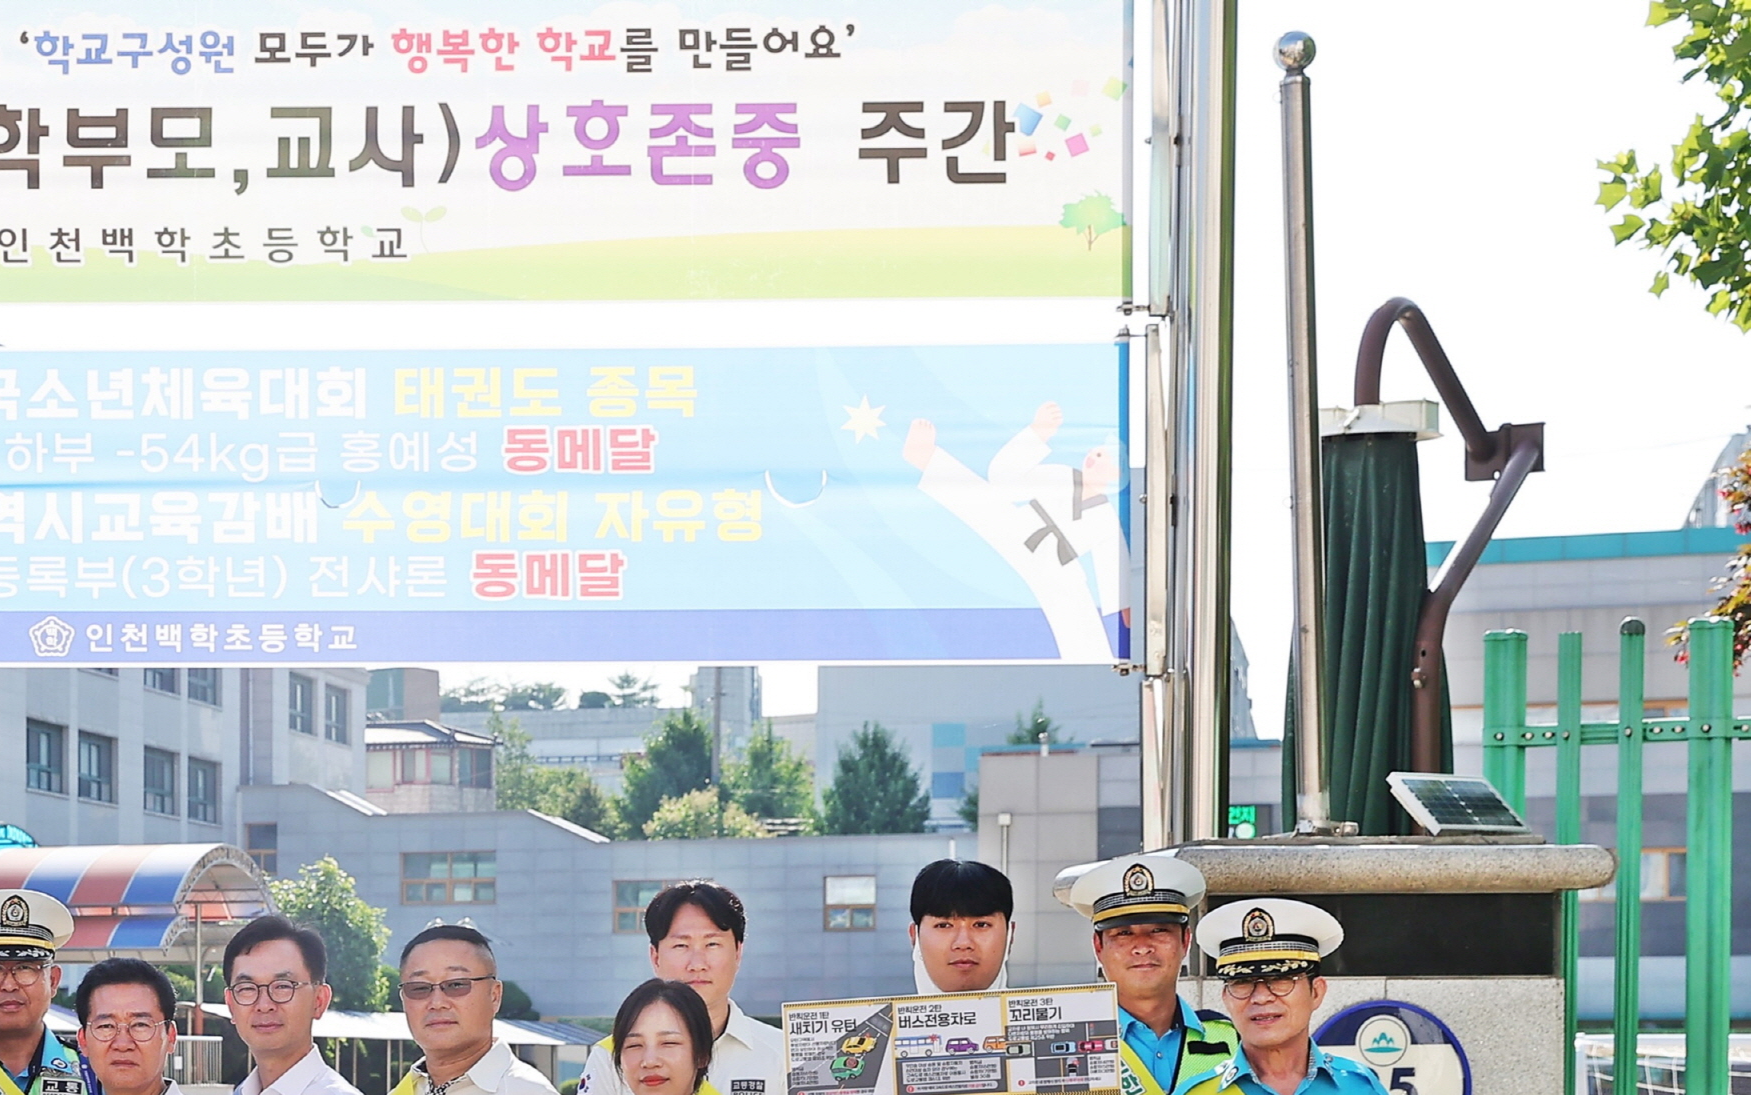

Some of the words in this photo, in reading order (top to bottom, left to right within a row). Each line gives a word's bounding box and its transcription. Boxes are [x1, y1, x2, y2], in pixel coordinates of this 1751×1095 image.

[254, 29, 375, 66] 모두가
[392, 28, 520, 75] 행복한
[537, 26, 659, 75] 학교를
[858, 98, 1016, 186] 주간
[393, 364, 562, 419] 태권도
[586, 363, 699, 418] 종목
[115, 430, 319, 483] -54kg급
[339, 429, 479, 474] 홍예성
[502, 426, 657, 473] 동메달
[342, 489, 569, 544] 수영대회
[593, 488, 764, 543] 자유형
[307, 554, 449, 599] 전샤론
[471, 551, 625, 599] 동메달
[85, 623, 358, 654] 인천백학초등학교
[790, 1019, 828, 1035] 새치기
[831, 1018, 857, 1034] 유턴
[898, 1011, 976, 1029] 버스전용차로
[1009, 1006, 1062, 1022] 꼬리물기
